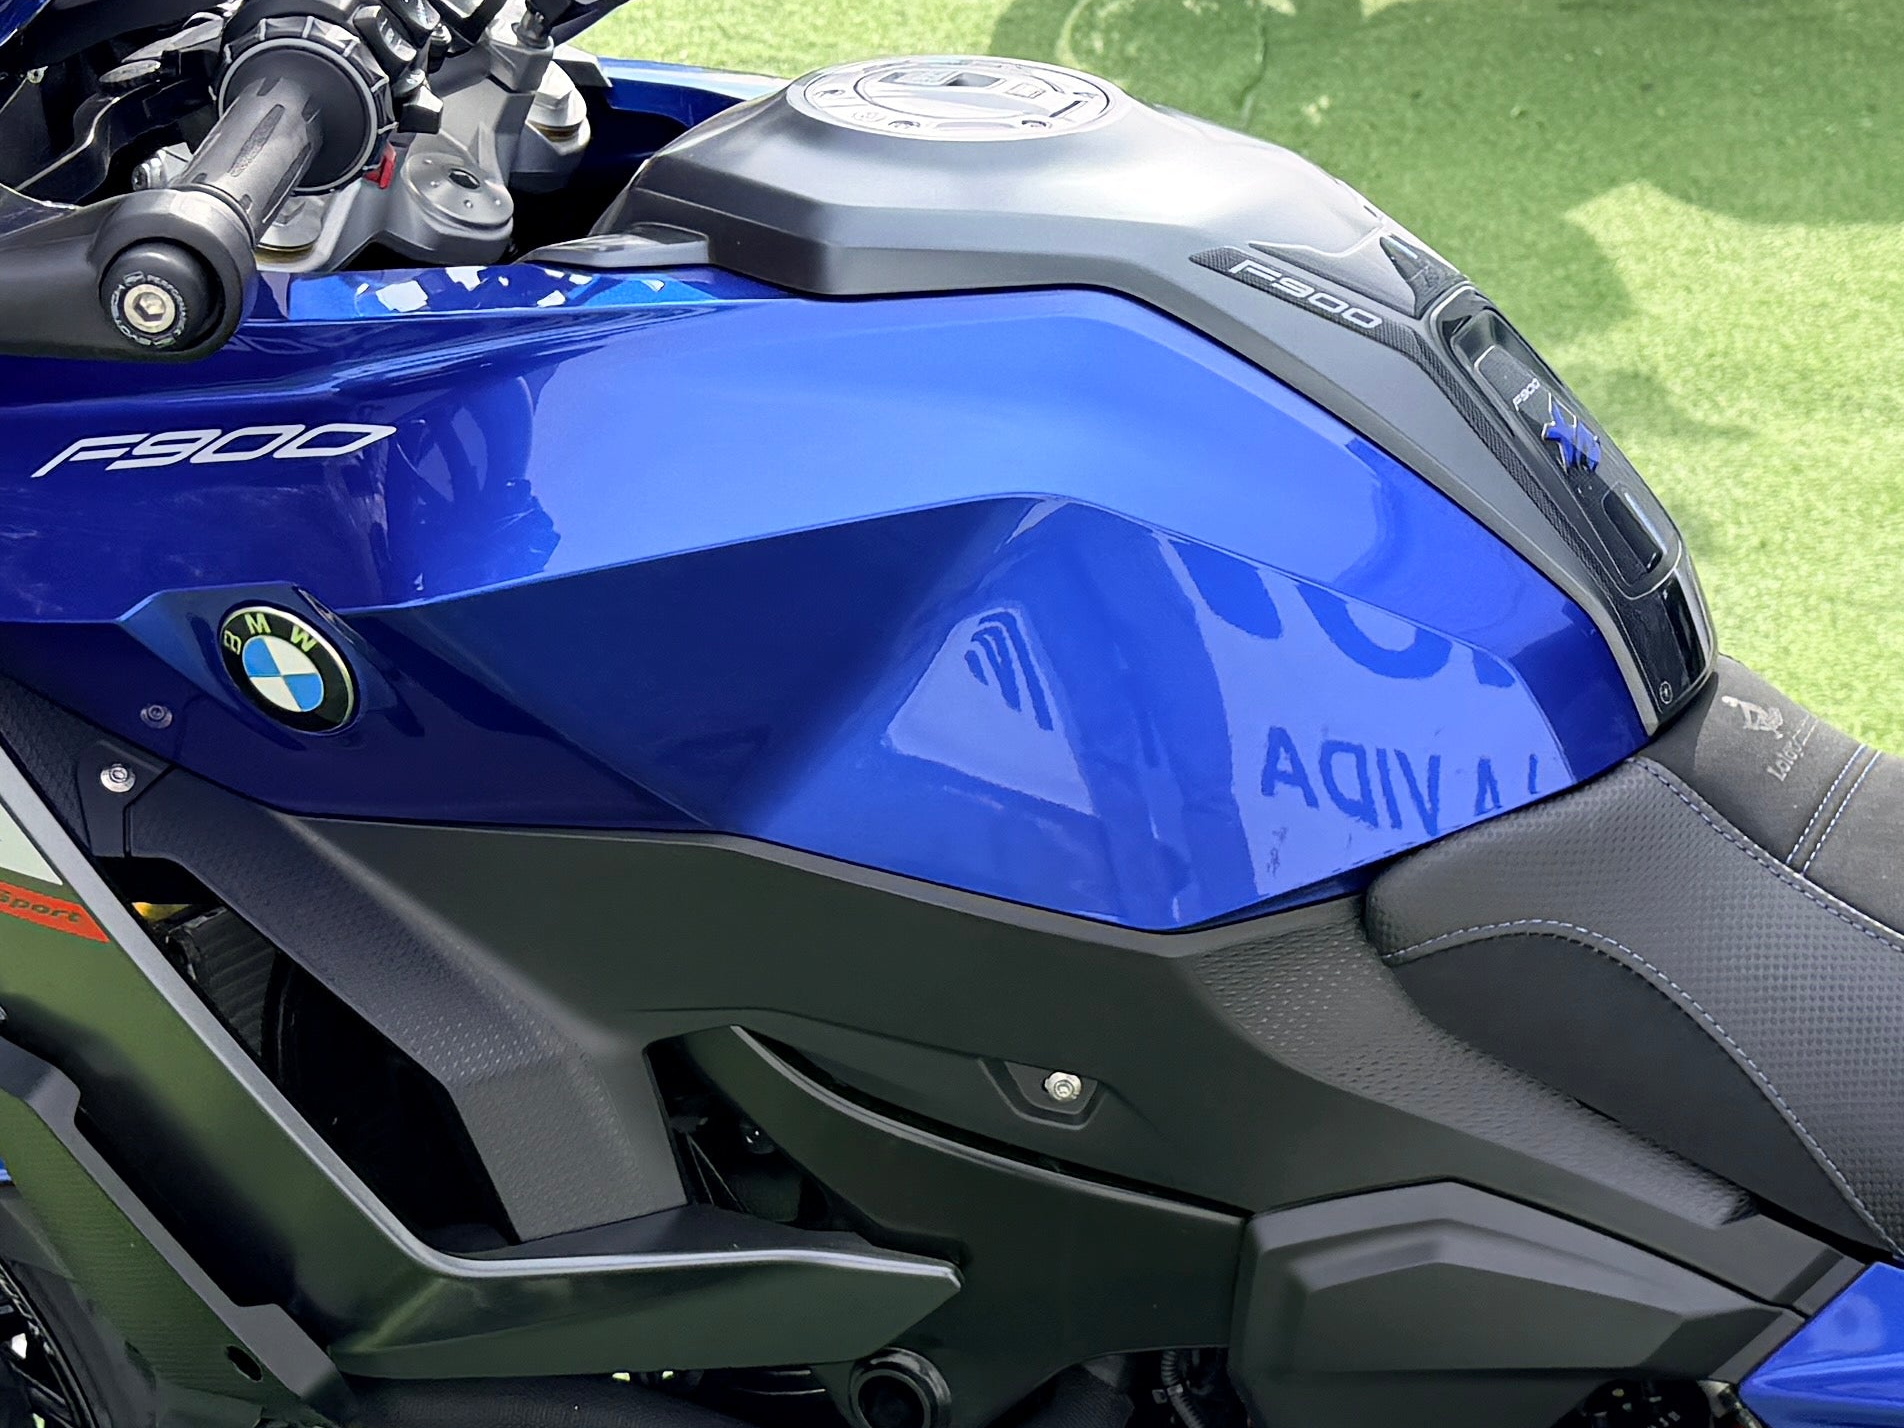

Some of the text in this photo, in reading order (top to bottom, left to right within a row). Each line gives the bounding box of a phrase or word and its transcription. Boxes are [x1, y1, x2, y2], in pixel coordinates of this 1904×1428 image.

[1228, 259, 1383, 329] F900
[1511, 376, 1542, 413] F900
[30, 422, 398, 479] F900
[223, 612, 318, 657] BMW
